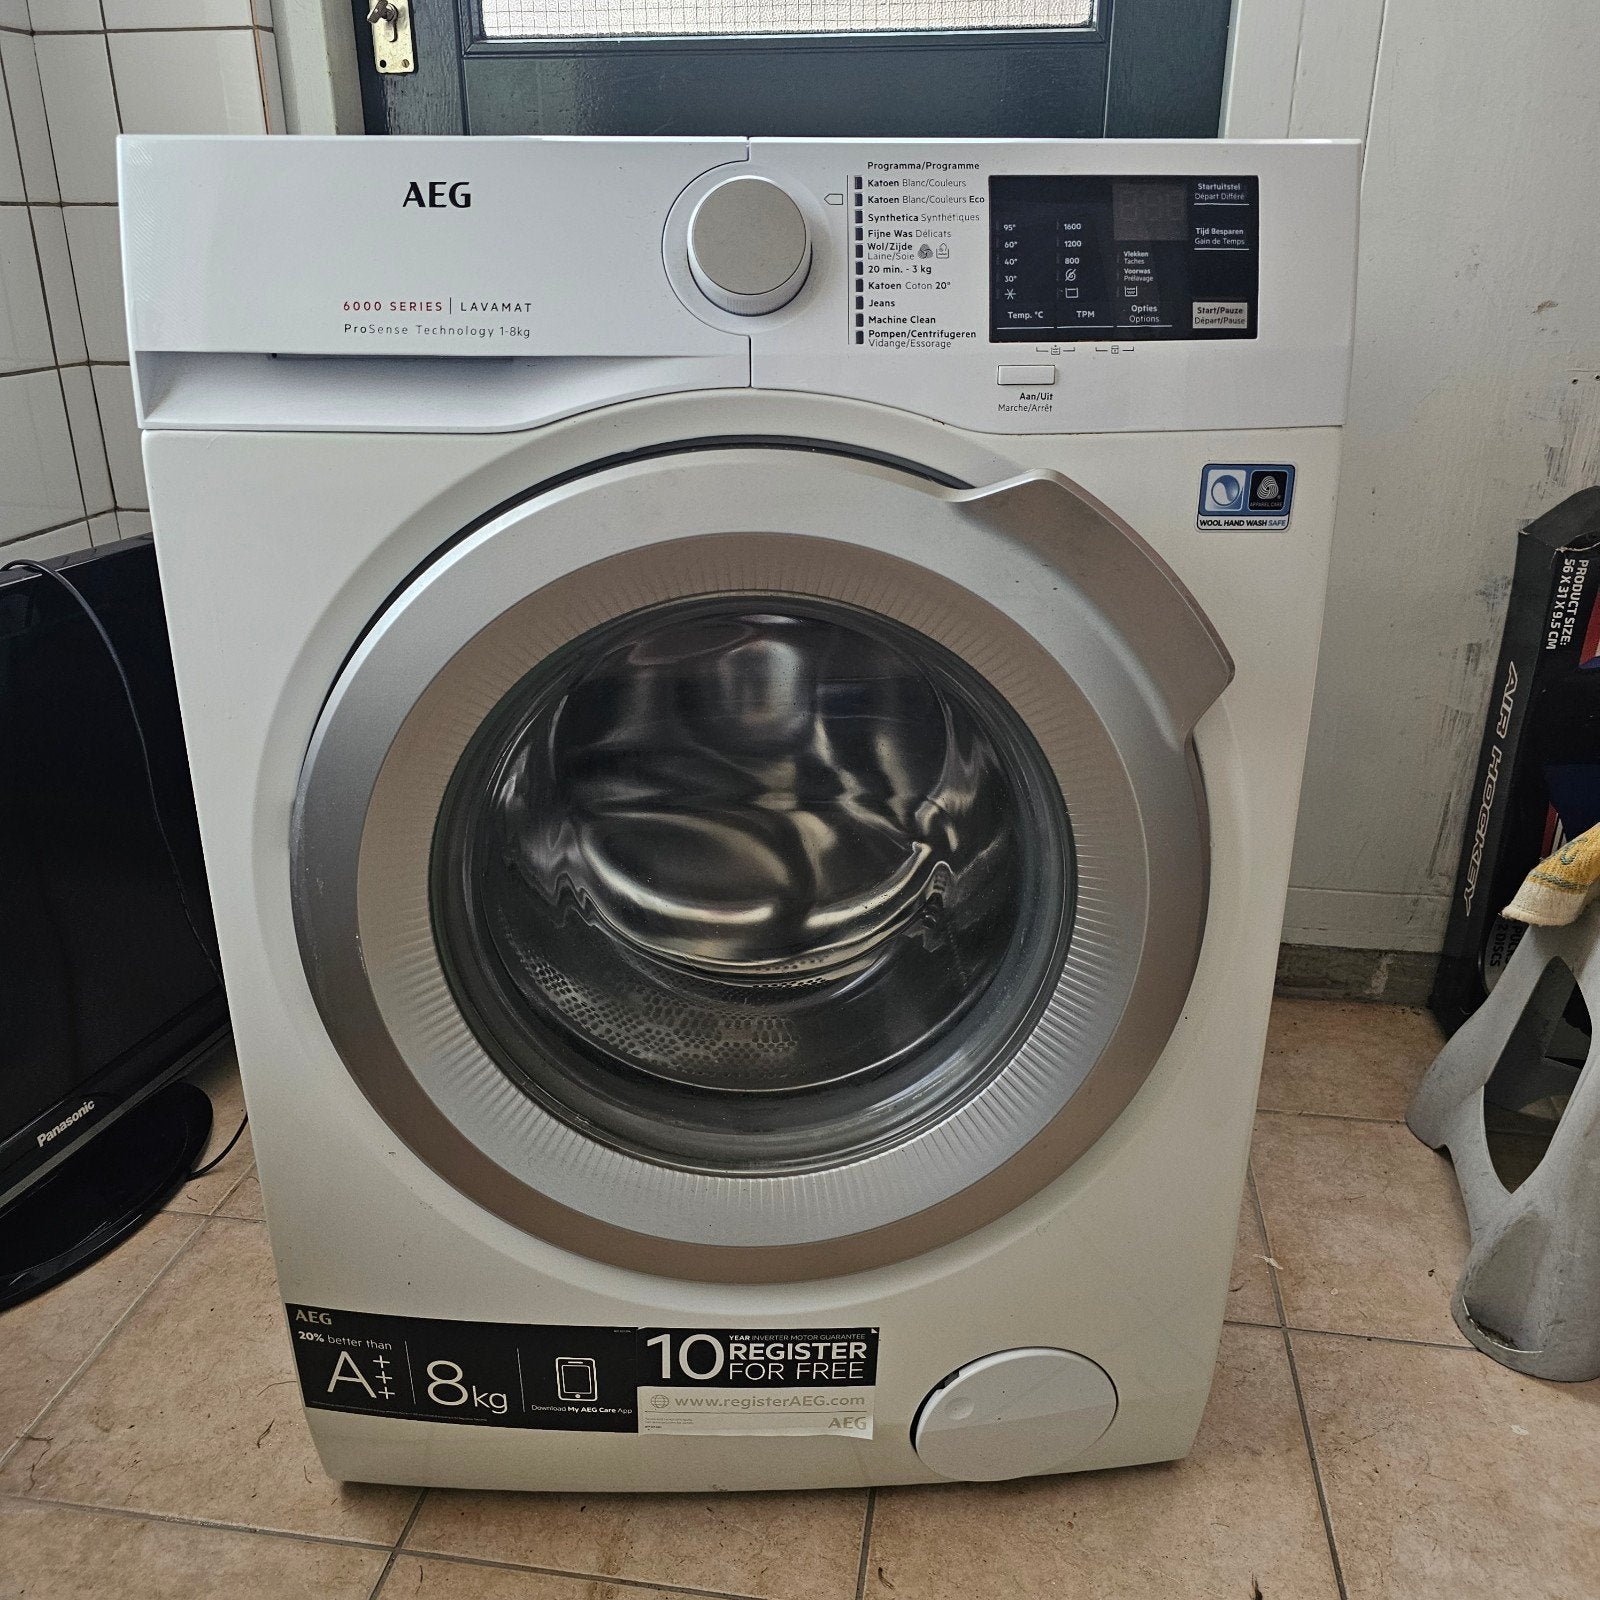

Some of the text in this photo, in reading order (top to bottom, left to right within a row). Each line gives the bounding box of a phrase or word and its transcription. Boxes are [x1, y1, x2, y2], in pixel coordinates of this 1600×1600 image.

[867, 162, 979, 171] Programma/Programme
[902, 179, 966, 187] Blanc/Couleurs
[403, 182, 471, 208] AEG
[902, 196, 966, 204] Blanc/Couleurs
[868, 214, 918, 222] Synthetica
[868, 230, 891, 238] Fijne
[1195, 228, 1244, 236] Tijd Besparen
[1223, 238, 1245, 246] Temps
[867, 243, 913, 251] Wol/Zijde
[868, 252, 914, 260] Laine/Soie
[920, 265, 931, 274] kg
[343, 302, 532, 312] 6000 SERIES LAVAMAT
[1131, 305, 1158, 313] Opties
[1197, 307, 1243, 315] Start/Pauze
[1008, 312, 1032, 320] Temp.
[1129, 315, 1160, 324] Options
[1194, 316, 1246, 325] Départ/Pause
[344, 324, 530, 338] ProSense Technology 1-8kg
[869, 330, 976, 339] Pompen/Centrifugeren
[869, 339, 951, 349] Vidange/Essorage
[1019, 392, 1053, 401] Aan/Uit
[998, 402, 1052, 412] Marche/Arrêt
[1546, 559, 1575, 650] 56 X 31 X 9.5 CM
[1560, 559, 1590, 645] PRODUCT SIZE:
[1464, 661, 1518, 916] AIR HOCKEY
[1490, 933, 1506, 966] DISCS
[37, 1101, 95, 1147] Panasonic
[295, 1309, 332, 1325] AEG
[298, 1331, 392, 1350] 20% better than
[729, 1342, 867, 1361] REGISTER
[646, 1333, 725, 1380] 10
[729, 1362, 864, 1380] FOR FREE
[675, 1395, 865, 1409] www.registerAEG.com
[828, 1417, 867, 1430] AEG
